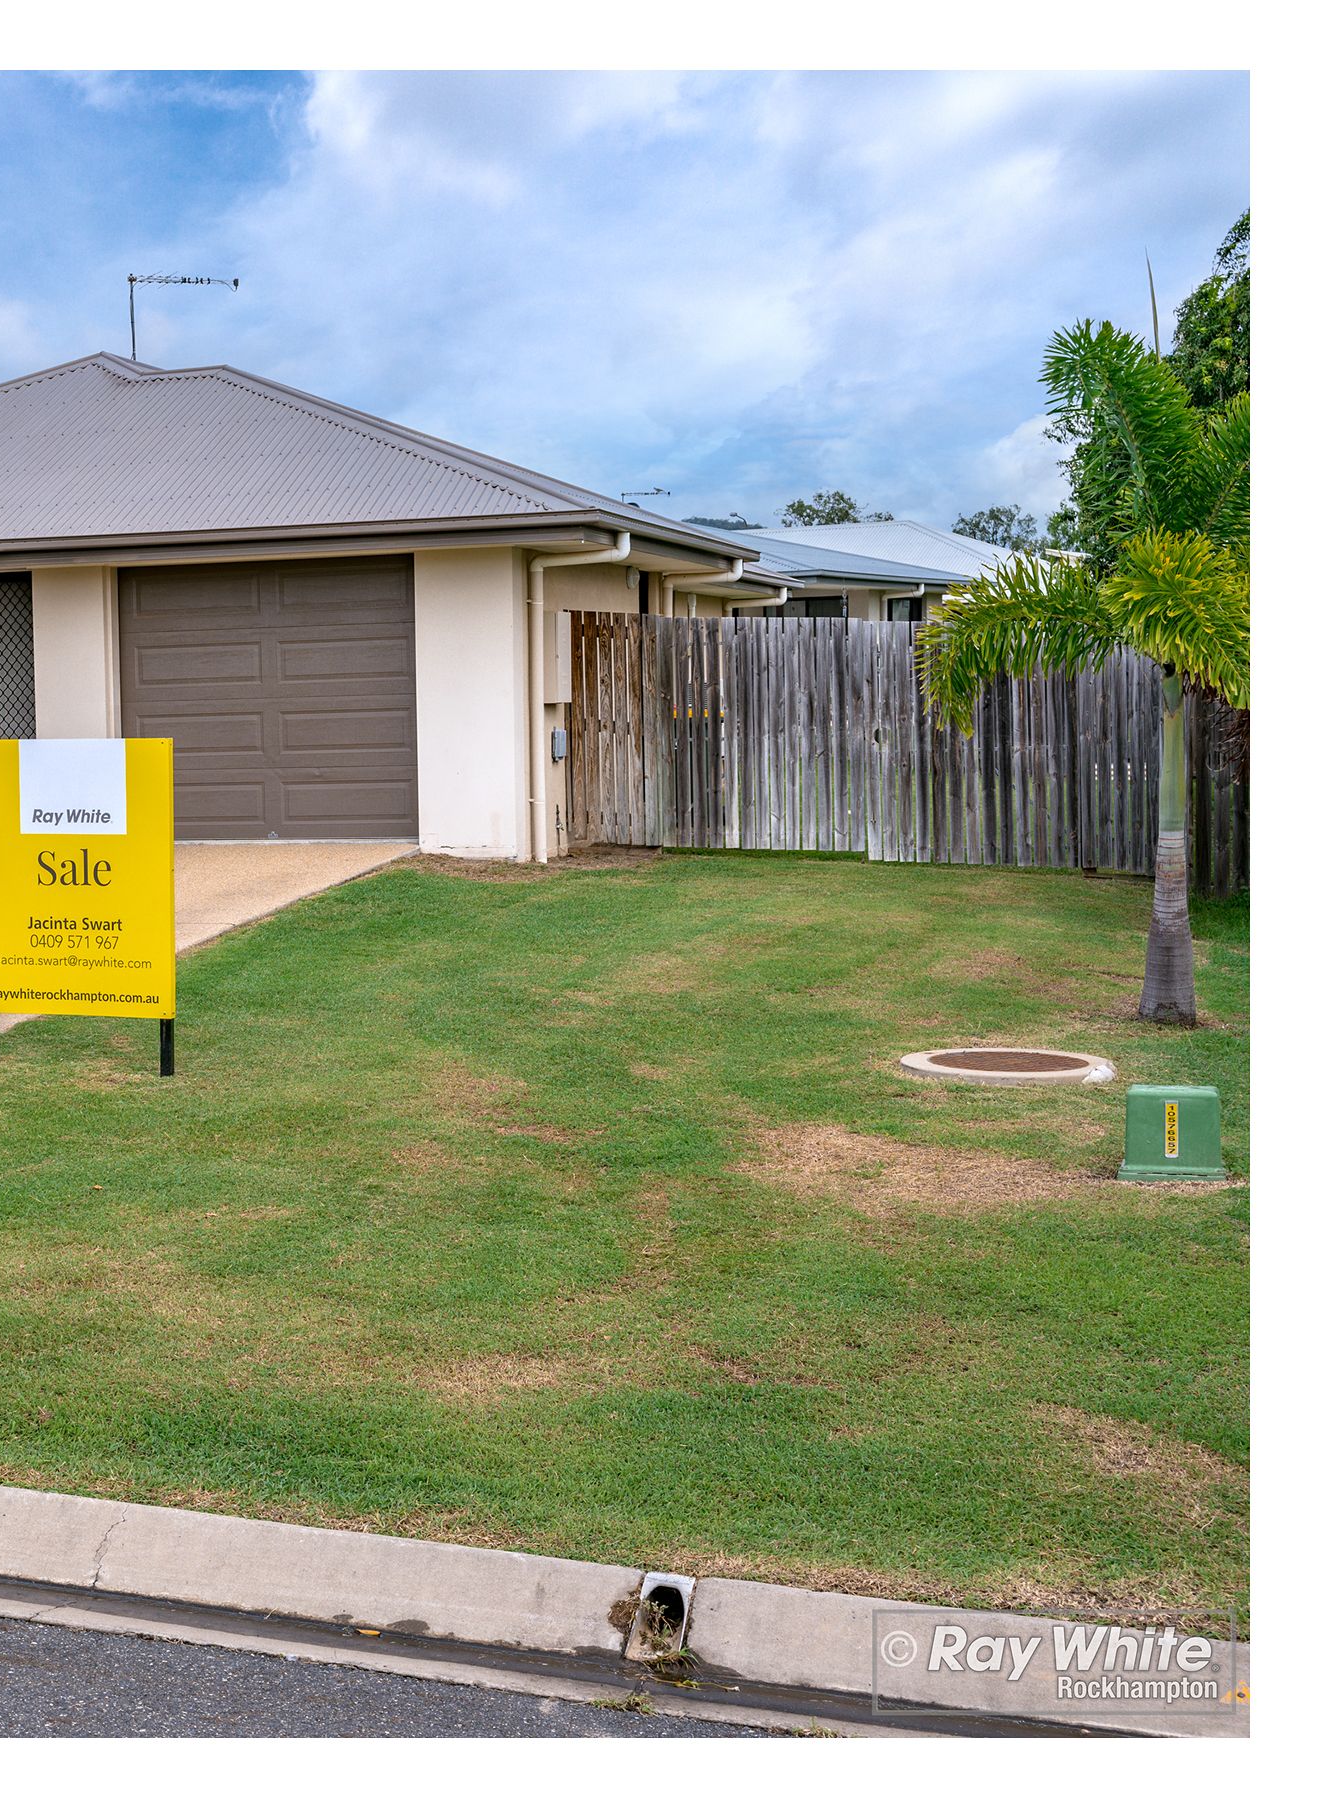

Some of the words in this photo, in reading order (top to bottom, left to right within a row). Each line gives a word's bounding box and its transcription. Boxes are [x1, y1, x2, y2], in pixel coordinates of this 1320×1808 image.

[32, 809, 63, 825] Ray
[66, 810, 111, 824] White
[37, 849, 112, 887] Sale
[27, 916, 78, 931] Jacinta
[82, 917, 123, 931] Swart
[30, 934, 63, 949] 0409
[67, 935, 91, 950] 571
[95, 936, 119, 950] 967
